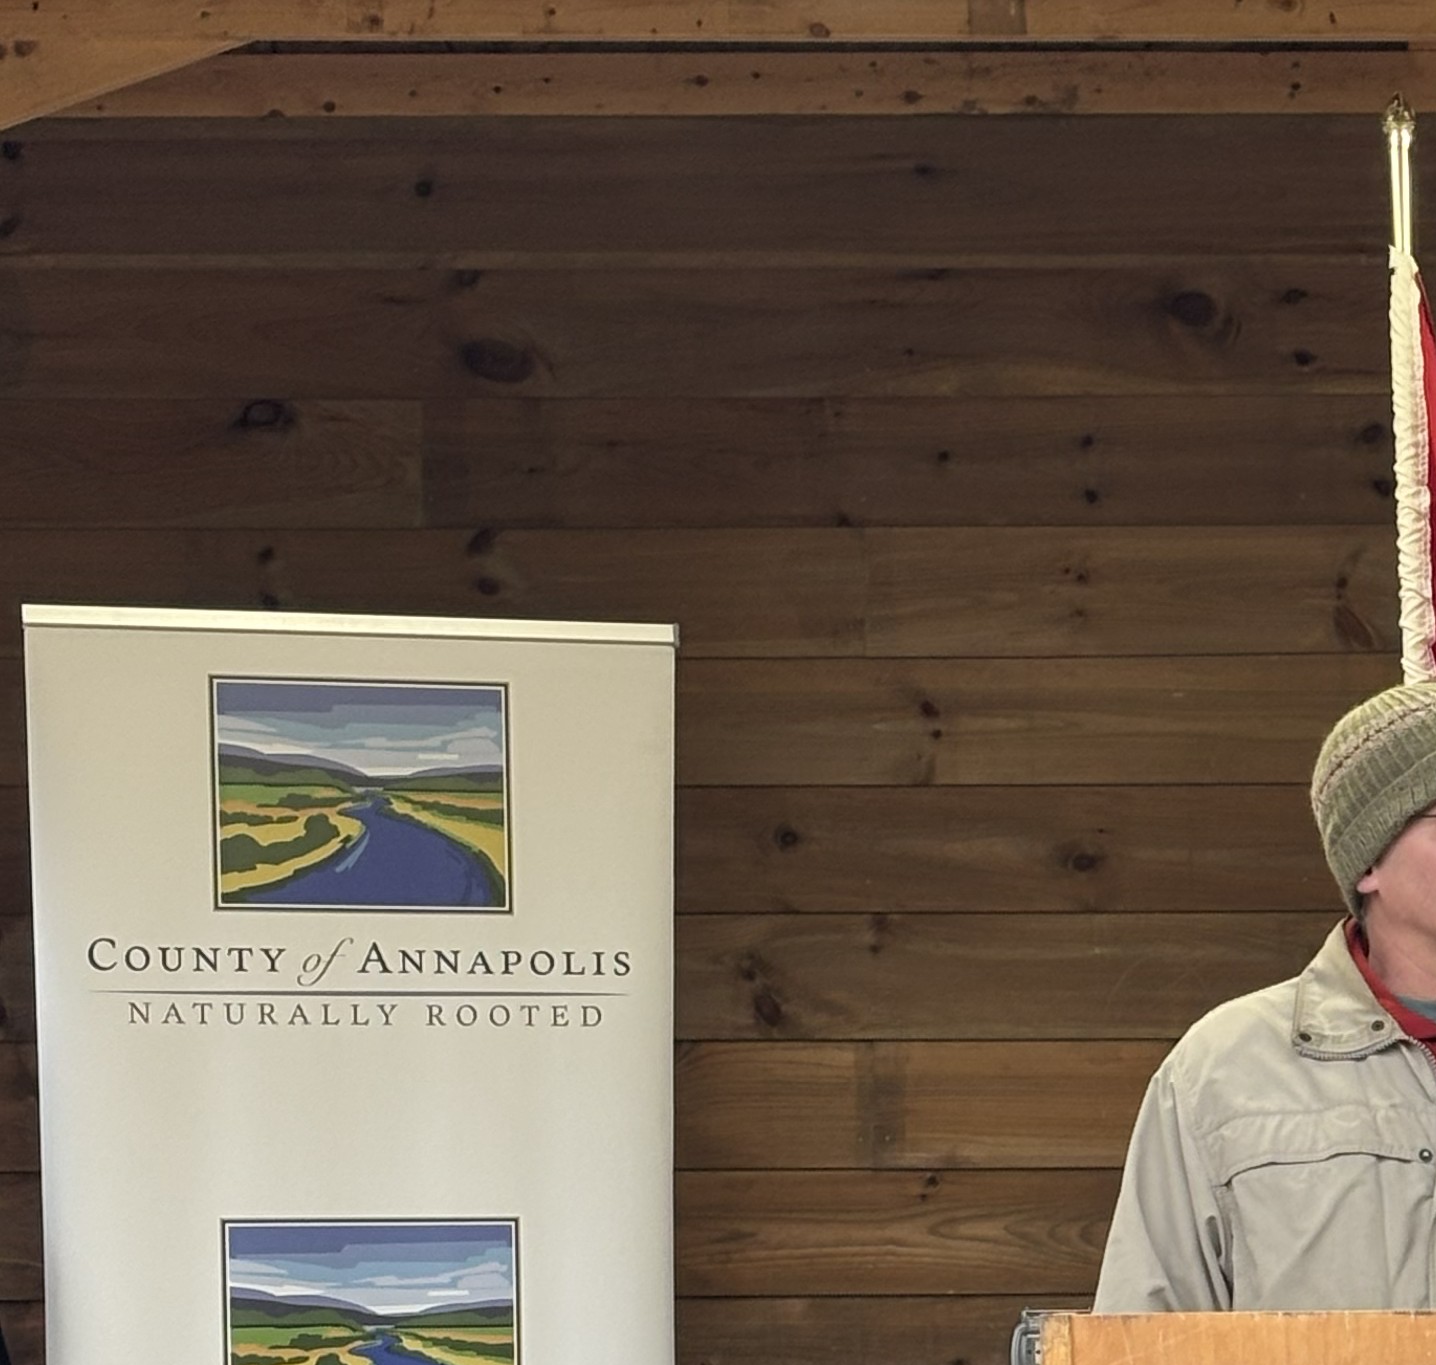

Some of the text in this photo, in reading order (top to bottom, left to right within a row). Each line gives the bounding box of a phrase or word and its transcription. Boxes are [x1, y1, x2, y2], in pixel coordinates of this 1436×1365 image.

[87, 937, 634, 987] COUNTY of ANNAPOLIS
[128, 1000, 606, 1029] NATURALLY ROOTED
